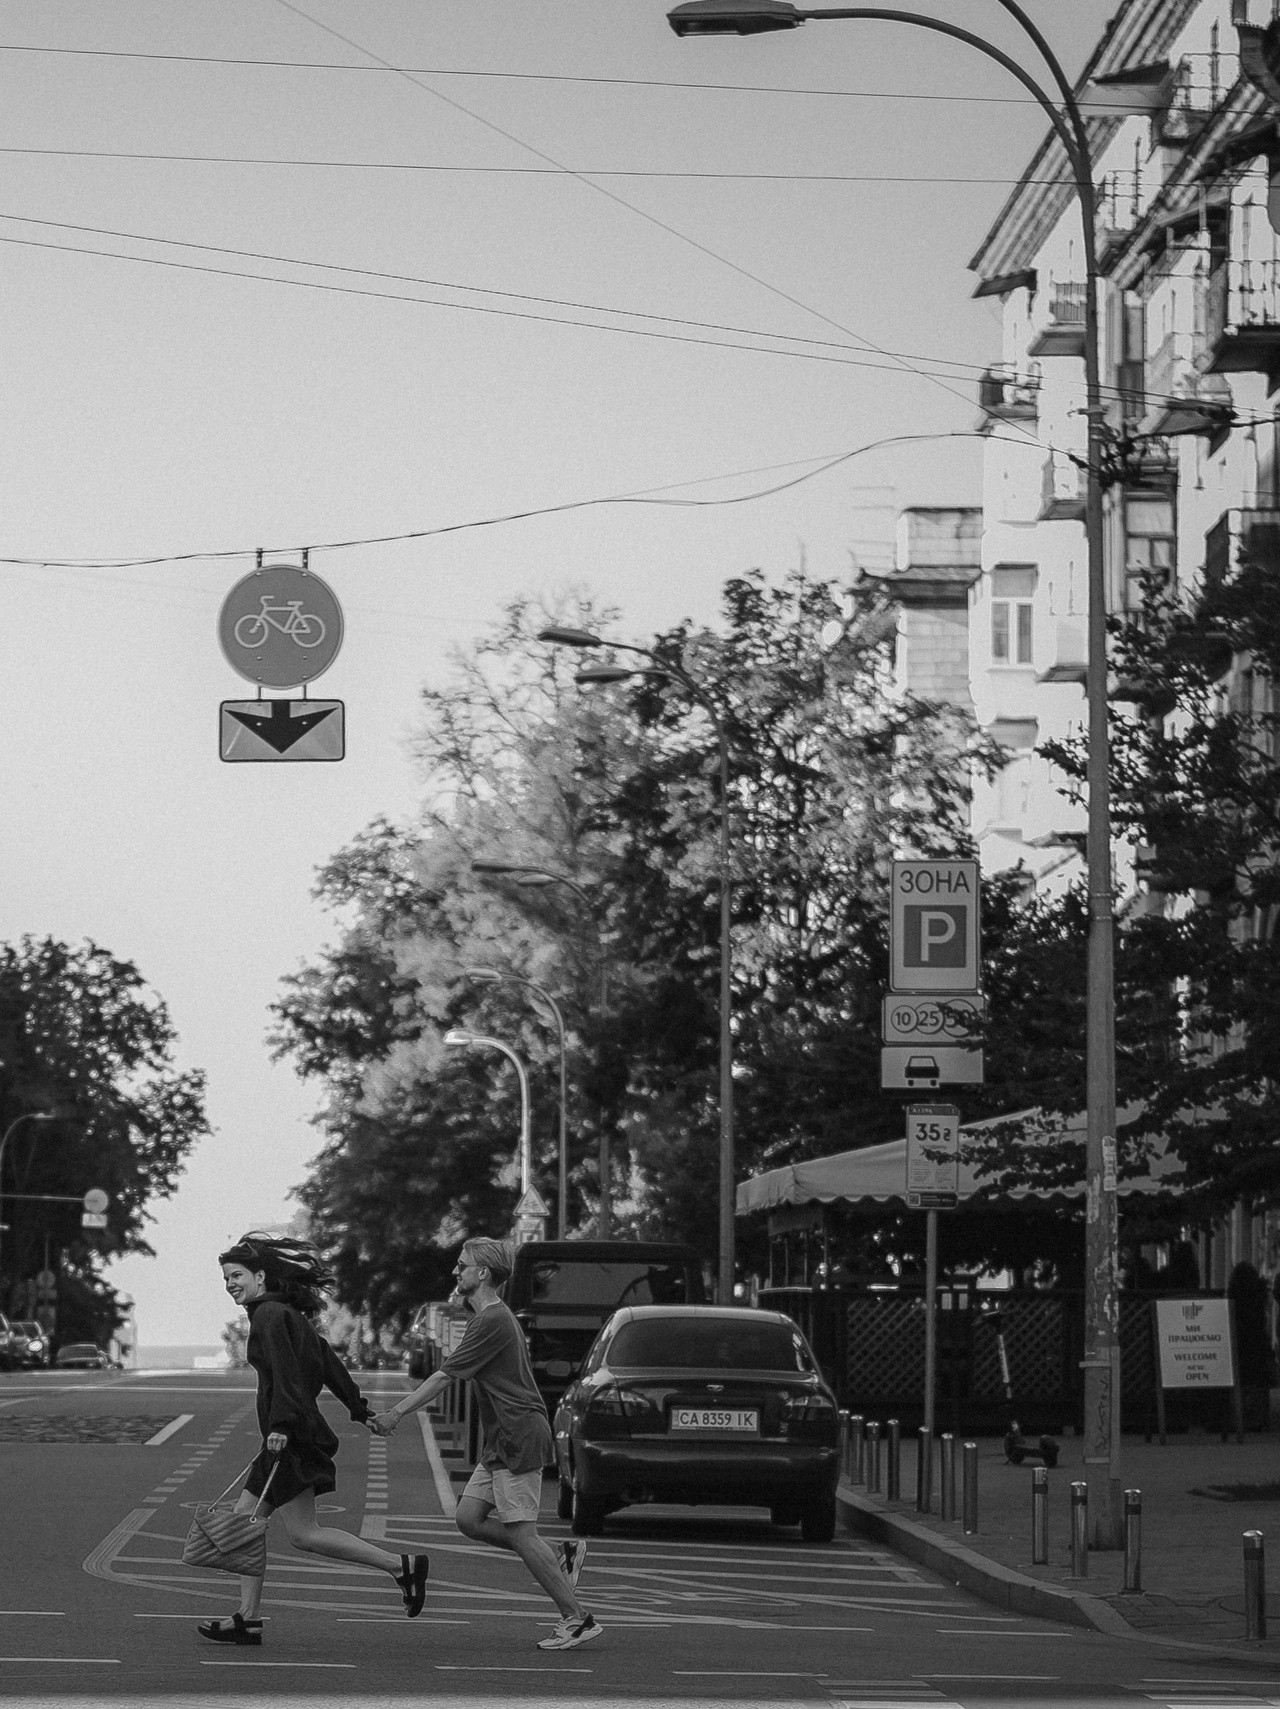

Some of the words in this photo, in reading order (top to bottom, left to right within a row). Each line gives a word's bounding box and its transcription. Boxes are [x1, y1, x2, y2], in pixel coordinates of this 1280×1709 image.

[899, 869, 971, 894] ЗОНА
[920, 910, 957, 962] P
[895, 1011, 912, 1027] 10
[918, 1010, 939, 1028] 25
[1173, 1352, 1218, 1361] WELCOME
[1185, 1372, 1210, 1381] OPEN
[680, 1412, 699, 1425] CA
[702, 1412, 732, 1426] 8359
[737, 1413, 754, 1427] IK
